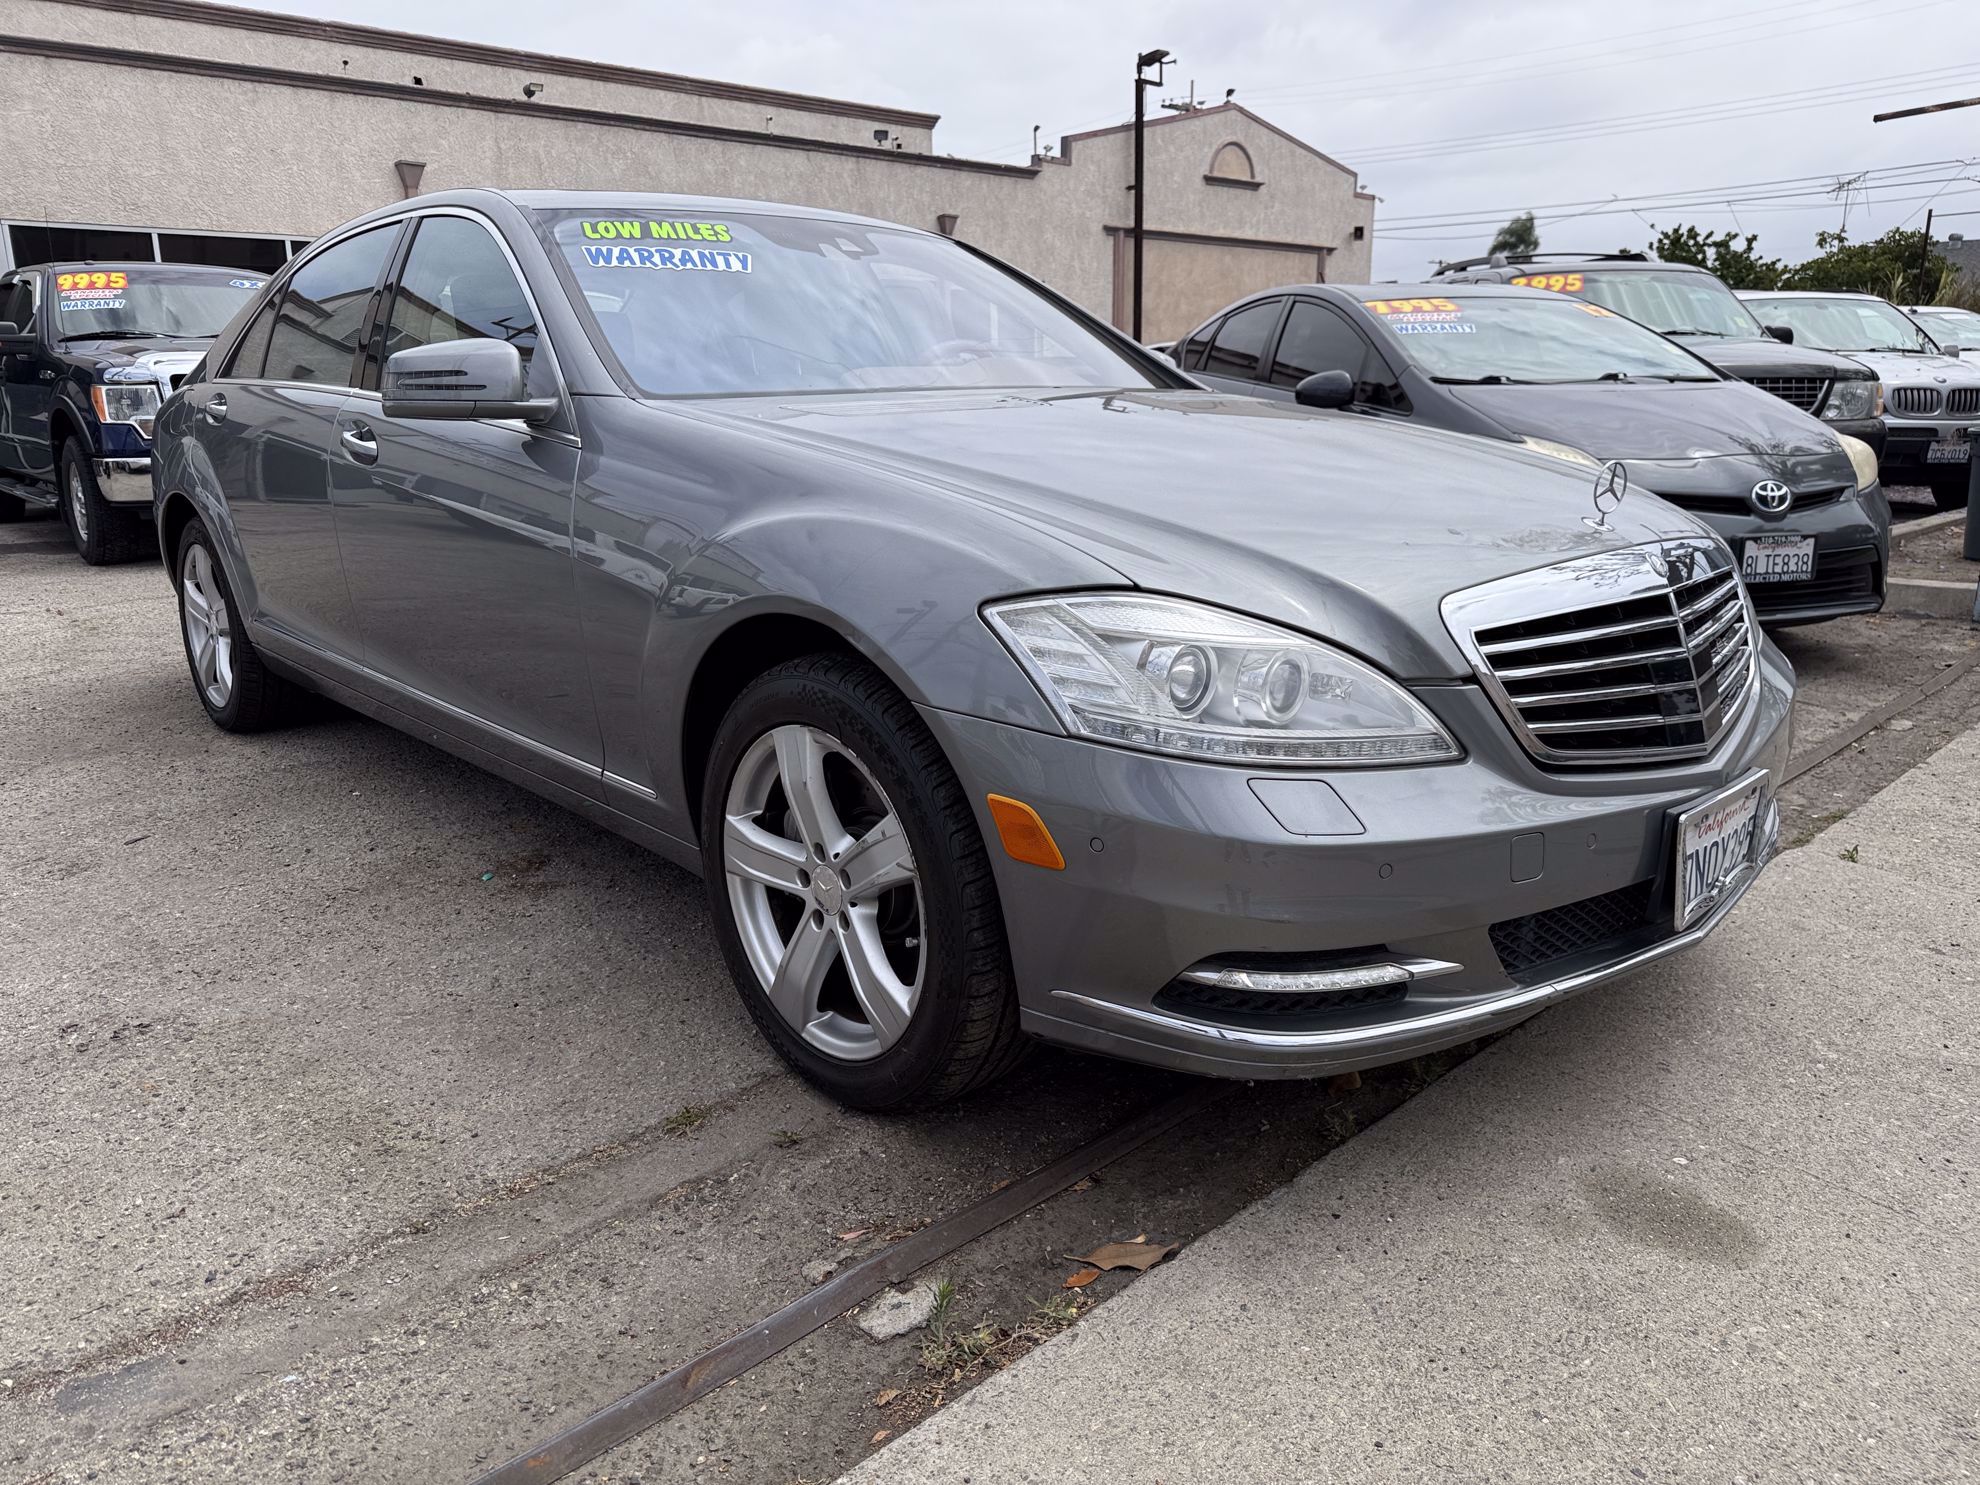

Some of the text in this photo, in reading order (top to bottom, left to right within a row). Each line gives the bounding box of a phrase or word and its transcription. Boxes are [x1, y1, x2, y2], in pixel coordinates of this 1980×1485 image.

[581, 221, 732, 242] LOW MILES
[583, 246, 750, 272] WARRANTY
[57, 272, 126, 290] 9995
[62, 299, 125, 310] WARRANTY
[1395, 323, 1475, 334] WARRANTY
[1697, 800, 1750, 839] California
